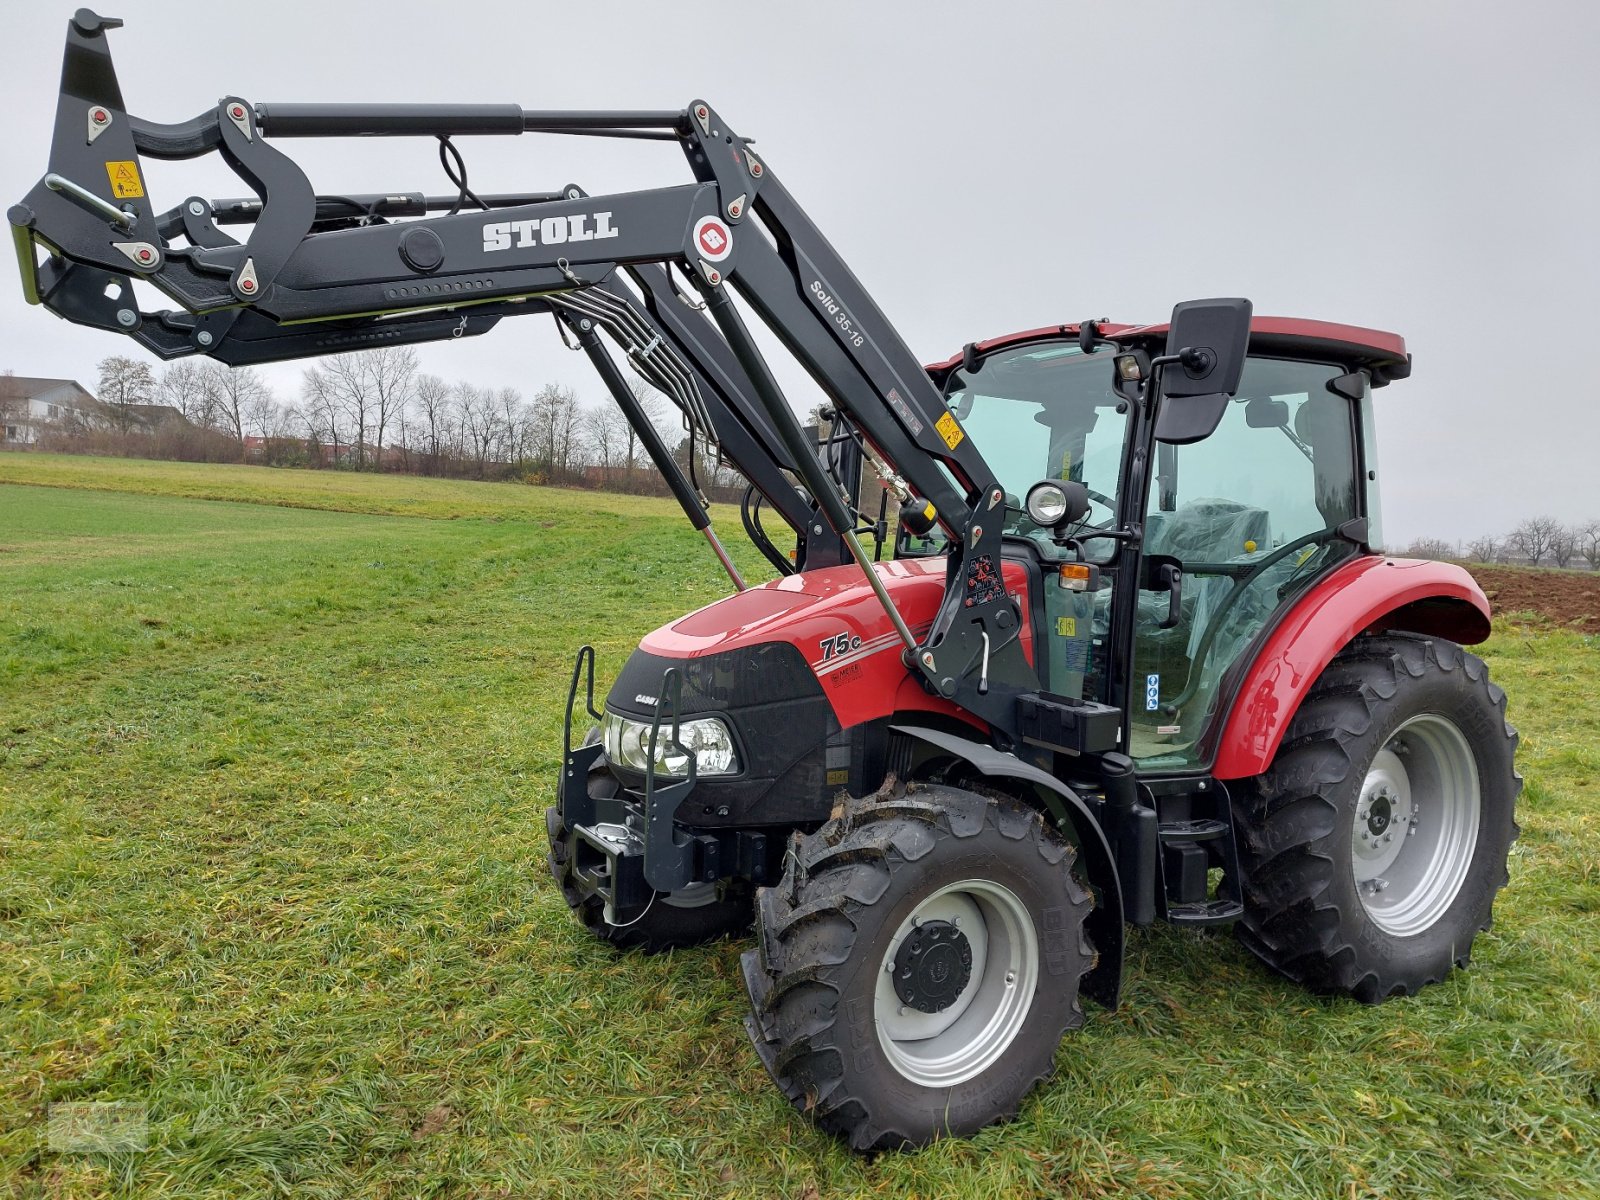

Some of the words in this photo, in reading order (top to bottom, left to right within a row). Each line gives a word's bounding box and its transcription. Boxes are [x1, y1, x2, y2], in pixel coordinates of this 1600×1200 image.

[483, 211, 619, 252] STOLL
[810, 280, 840, 315] Solid
[835, 312, 864, 347] 35-18
